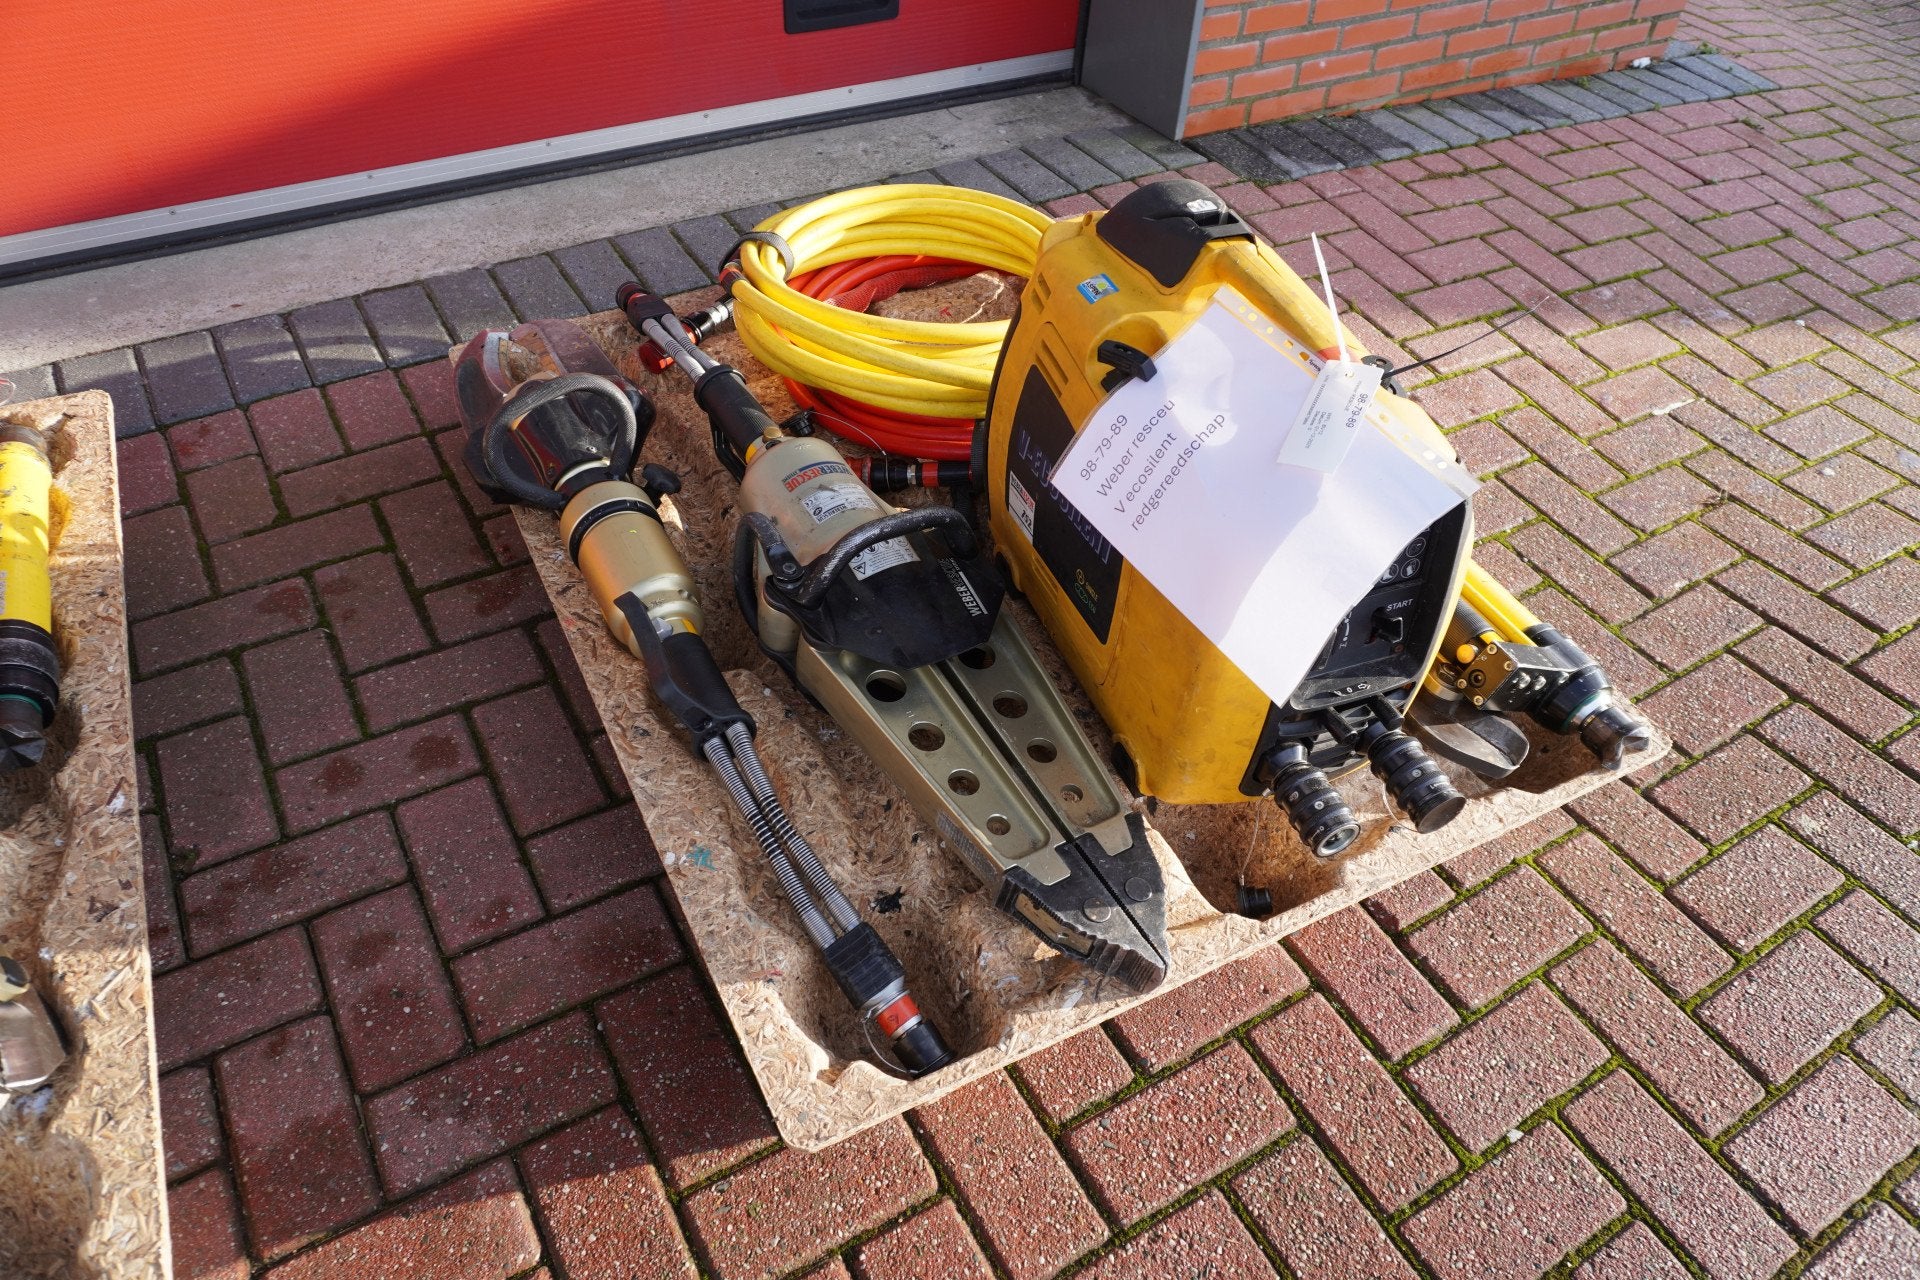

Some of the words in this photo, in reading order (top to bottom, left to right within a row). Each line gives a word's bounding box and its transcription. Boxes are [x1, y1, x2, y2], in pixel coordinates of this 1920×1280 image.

[1085, 281, 1101, 296] ASPEN
[1080, 414, 1129, 481] 98-79-89
[1096, 448, 1135, 497] Weber
[1132, 398, 1176, 449] resceu
[1114, 500, 1126, 514] V
[1126, 431, 1178, 502] ecosilent
[1131, 412, 1226, 531] redgereedschap
[1386, 598, 1414, 612] START
